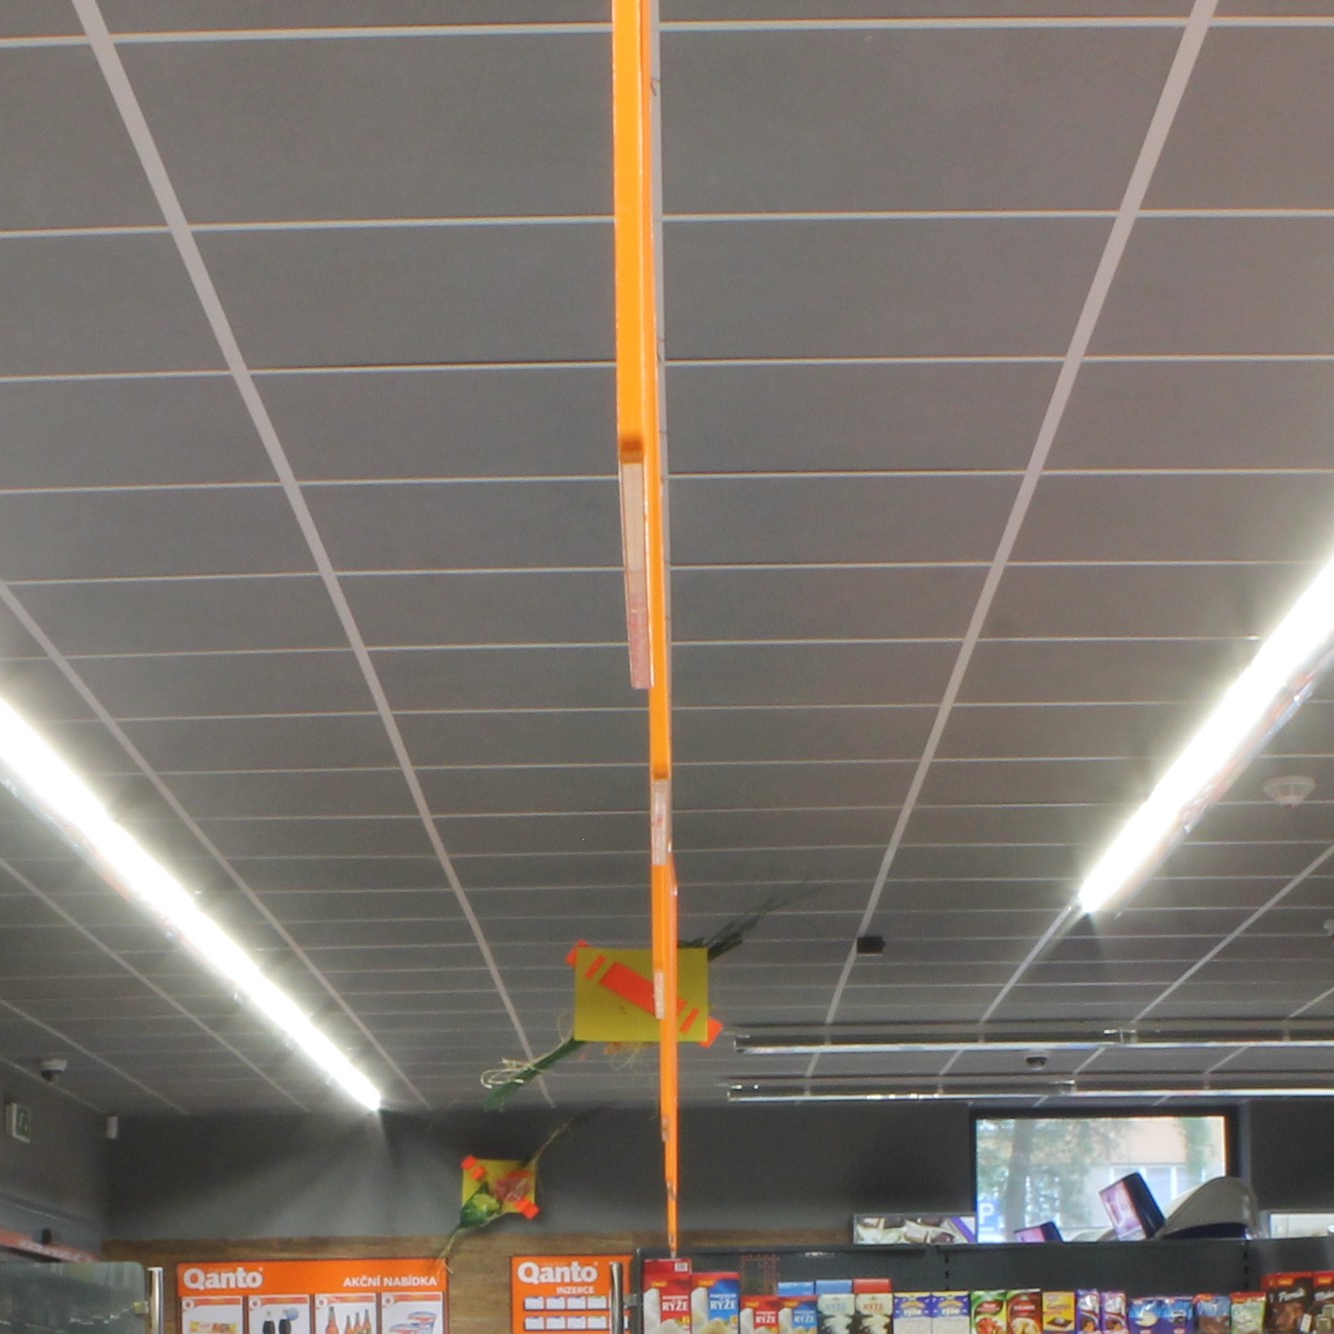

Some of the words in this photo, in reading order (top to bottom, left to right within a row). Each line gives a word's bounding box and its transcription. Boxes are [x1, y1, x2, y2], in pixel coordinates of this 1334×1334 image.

[183, 1267, 263, 1290] Qanto
[343, 1274, 381, 1287] AKČNÍ
[383, 1274, 438, 1287] NABÍDKA
[517, 1261, 598, 1284] Qanto
[556, 1286, 595, 1294] INZERCE
